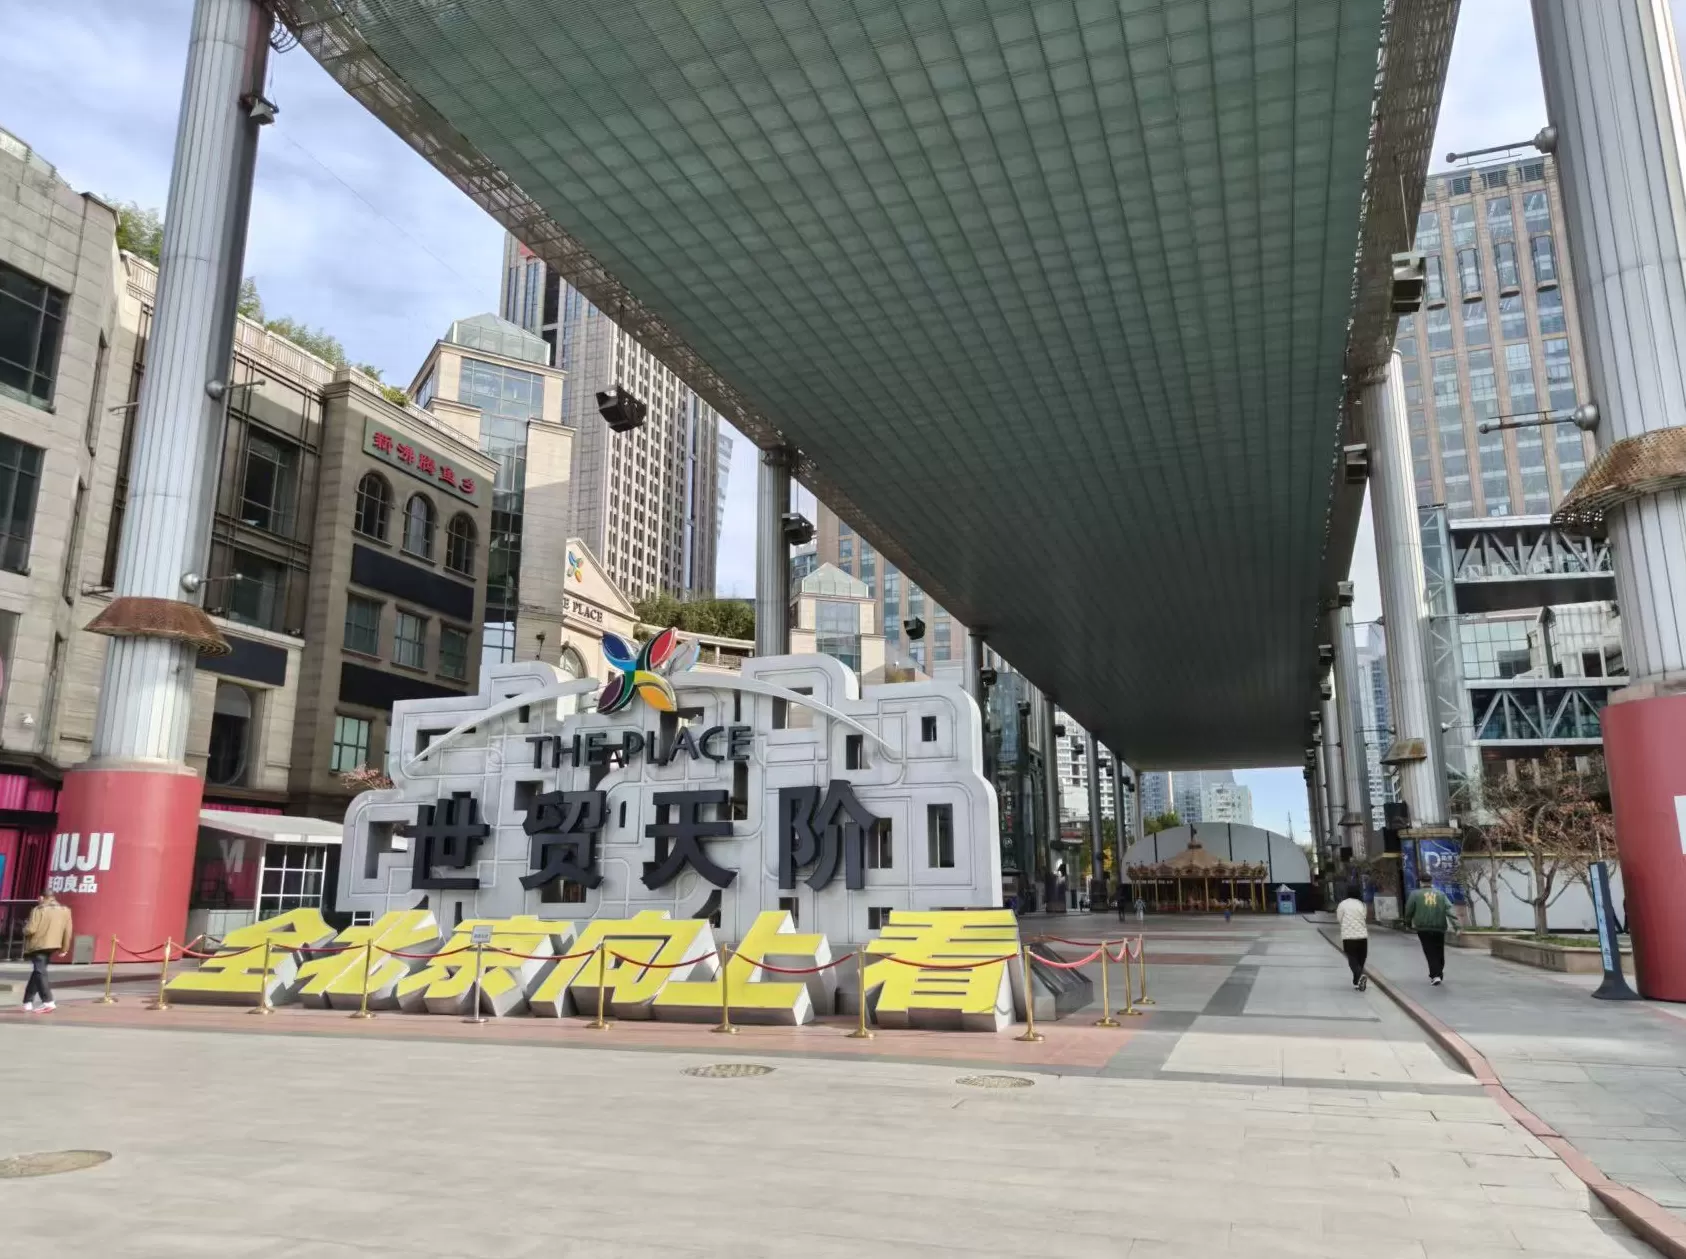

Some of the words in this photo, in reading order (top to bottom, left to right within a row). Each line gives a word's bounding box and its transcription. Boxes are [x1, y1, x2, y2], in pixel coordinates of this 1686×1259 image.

[573, 600, 603, 623] PLACE
[525, 733, 606, 769] THE
[622, 725, 752, 766] PLACE
[404, 780, 878, 890] 世贸天阶
